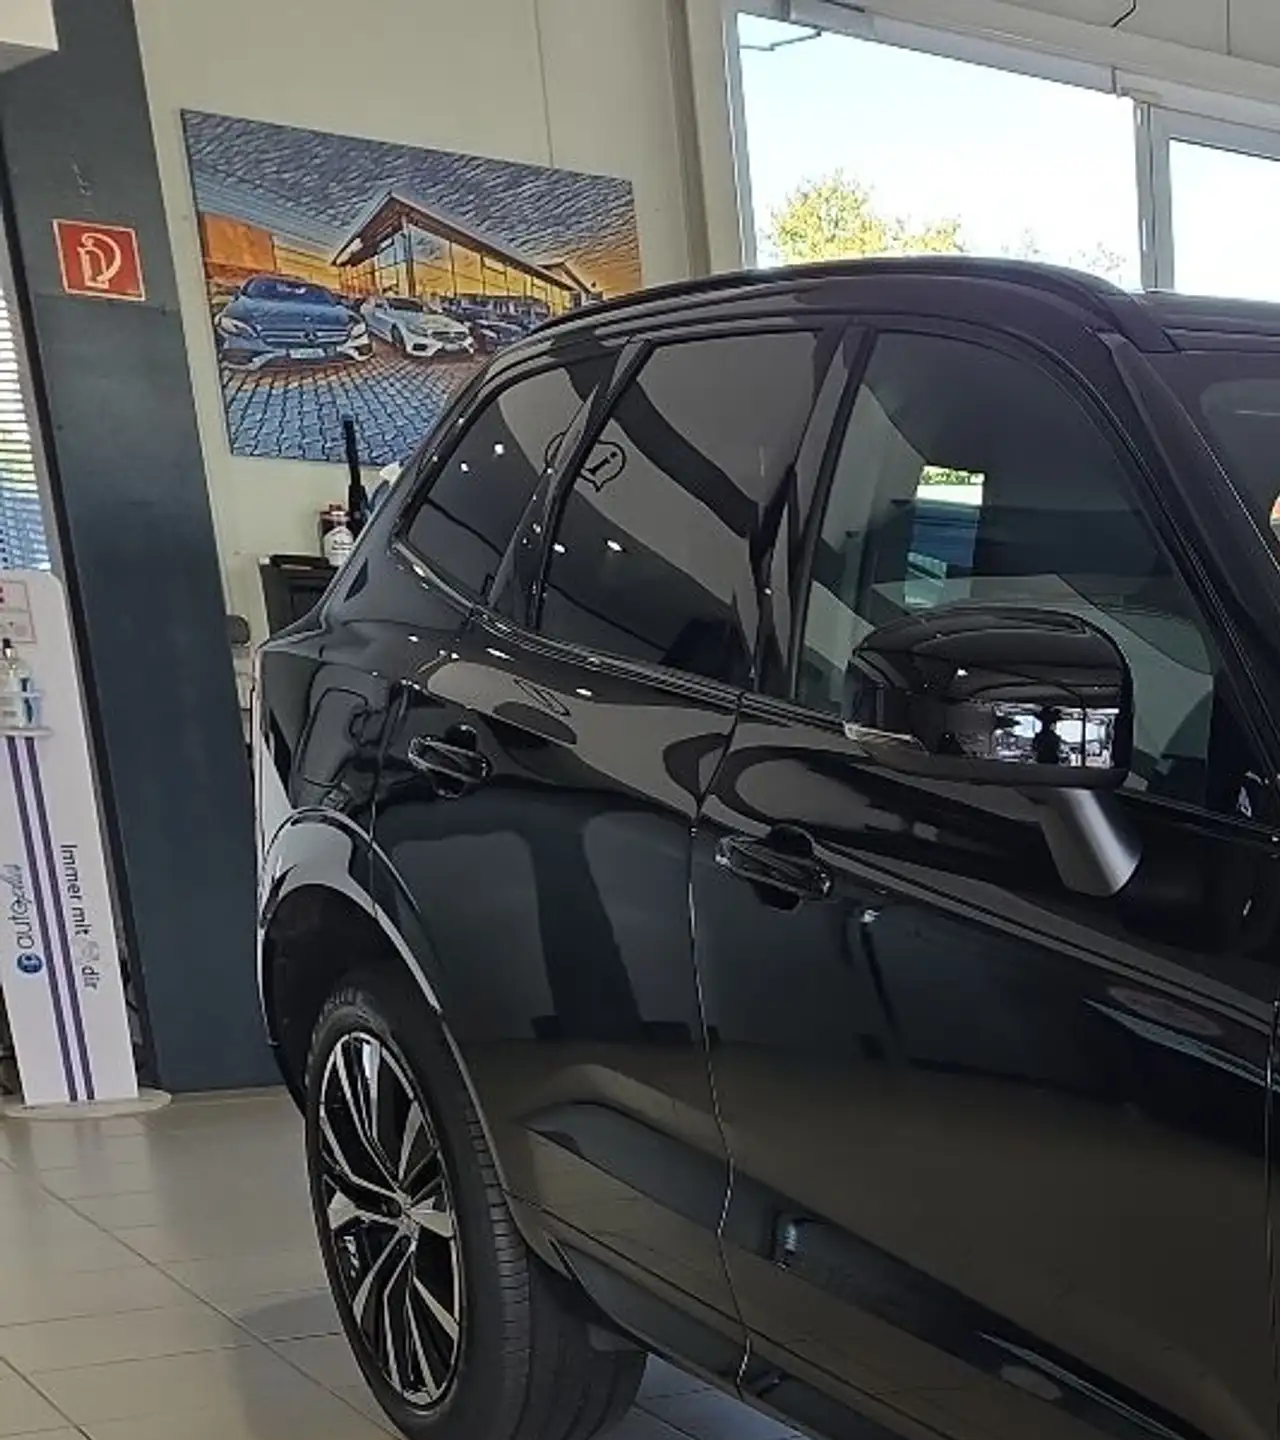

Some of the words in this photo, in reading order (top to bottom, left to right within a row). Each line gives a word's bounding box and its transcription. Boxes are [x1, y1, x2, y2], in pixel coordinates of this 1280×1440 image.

[60, 844, 81, 900] Immer
[71, 907, 92, 935] mit
[81, 965, 101, 990] dir
